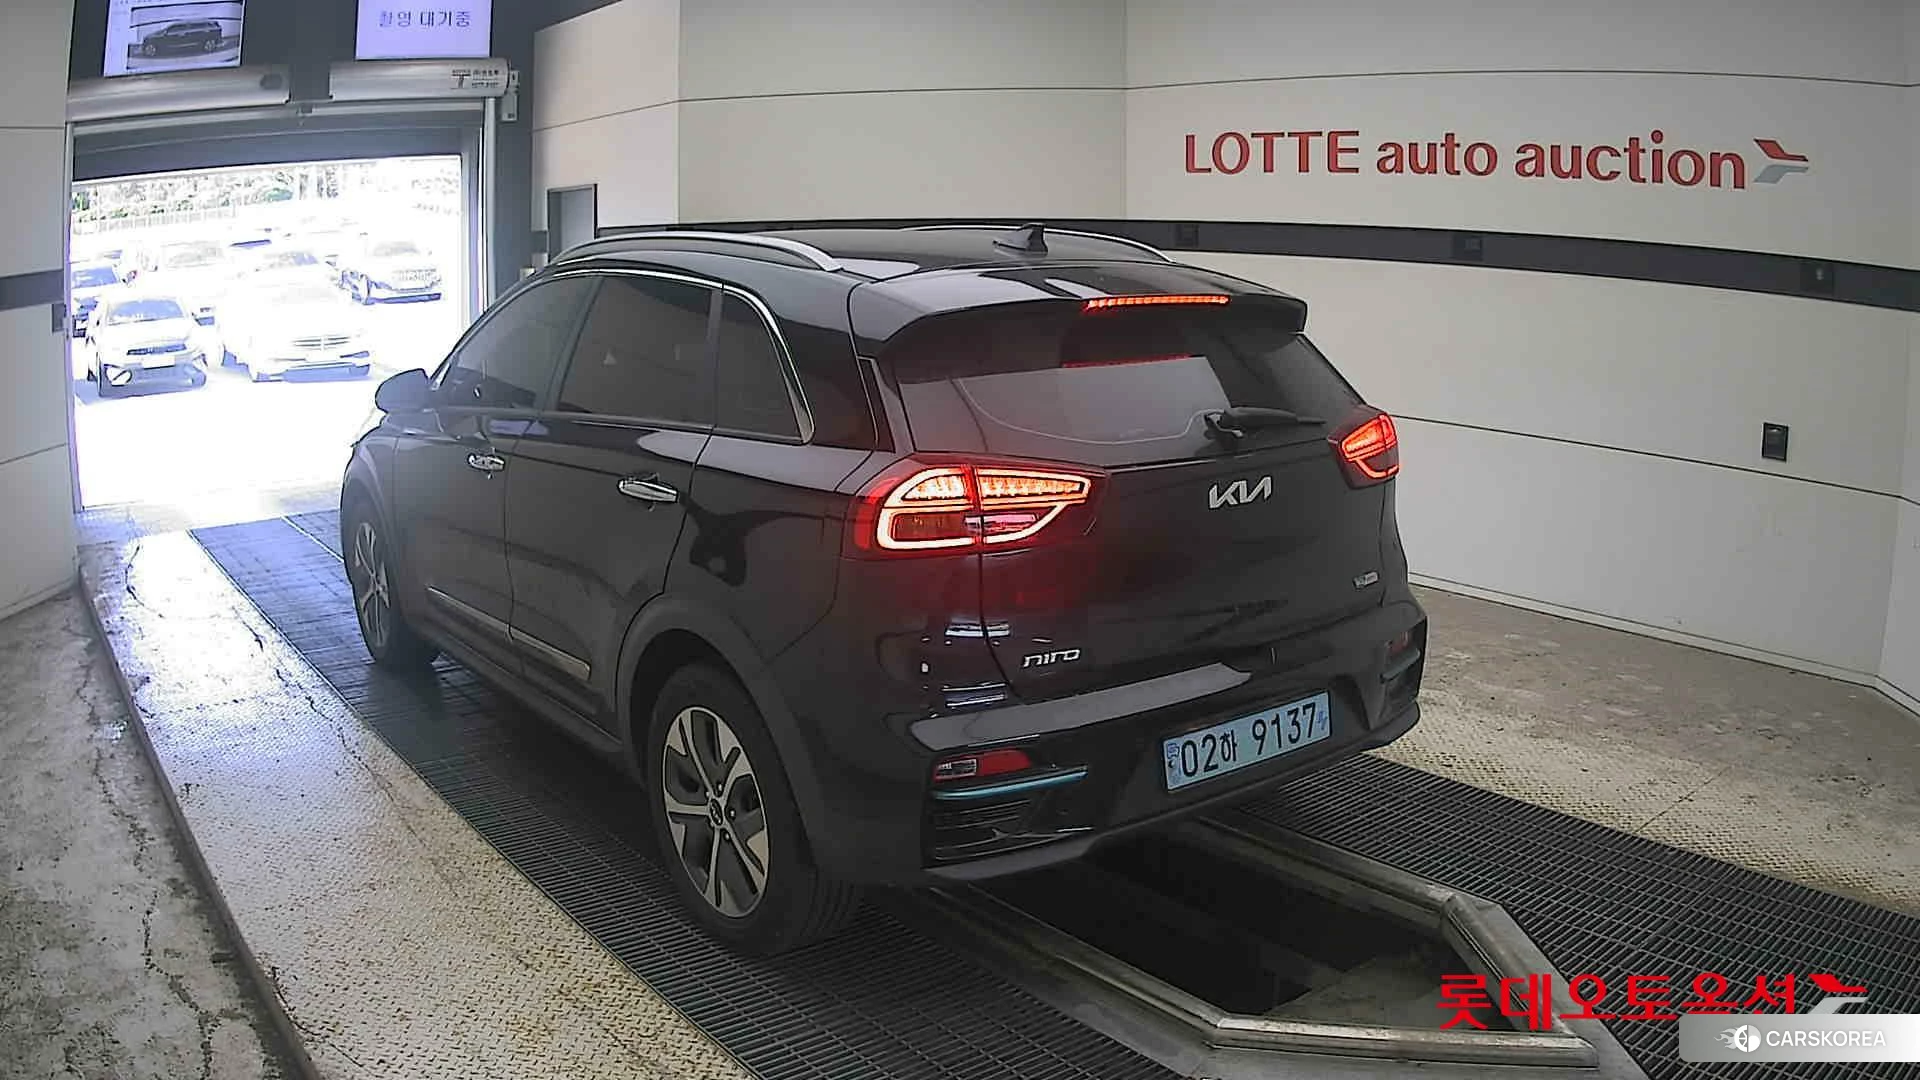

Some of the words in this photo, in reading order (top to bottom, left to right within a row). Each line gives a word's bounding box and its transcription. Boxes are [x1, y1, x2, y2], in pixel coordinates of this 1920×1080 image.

[419, 10, 471, 27] 대기중
[1185, 130, 1360, 175] LOTTE
[1375, 132, 1498, 176] auto
[1514, 129, 1745, 189] auction
[1181, 733, 1238, 778] 02하
[1251, 702, 1316, 756] 9137
